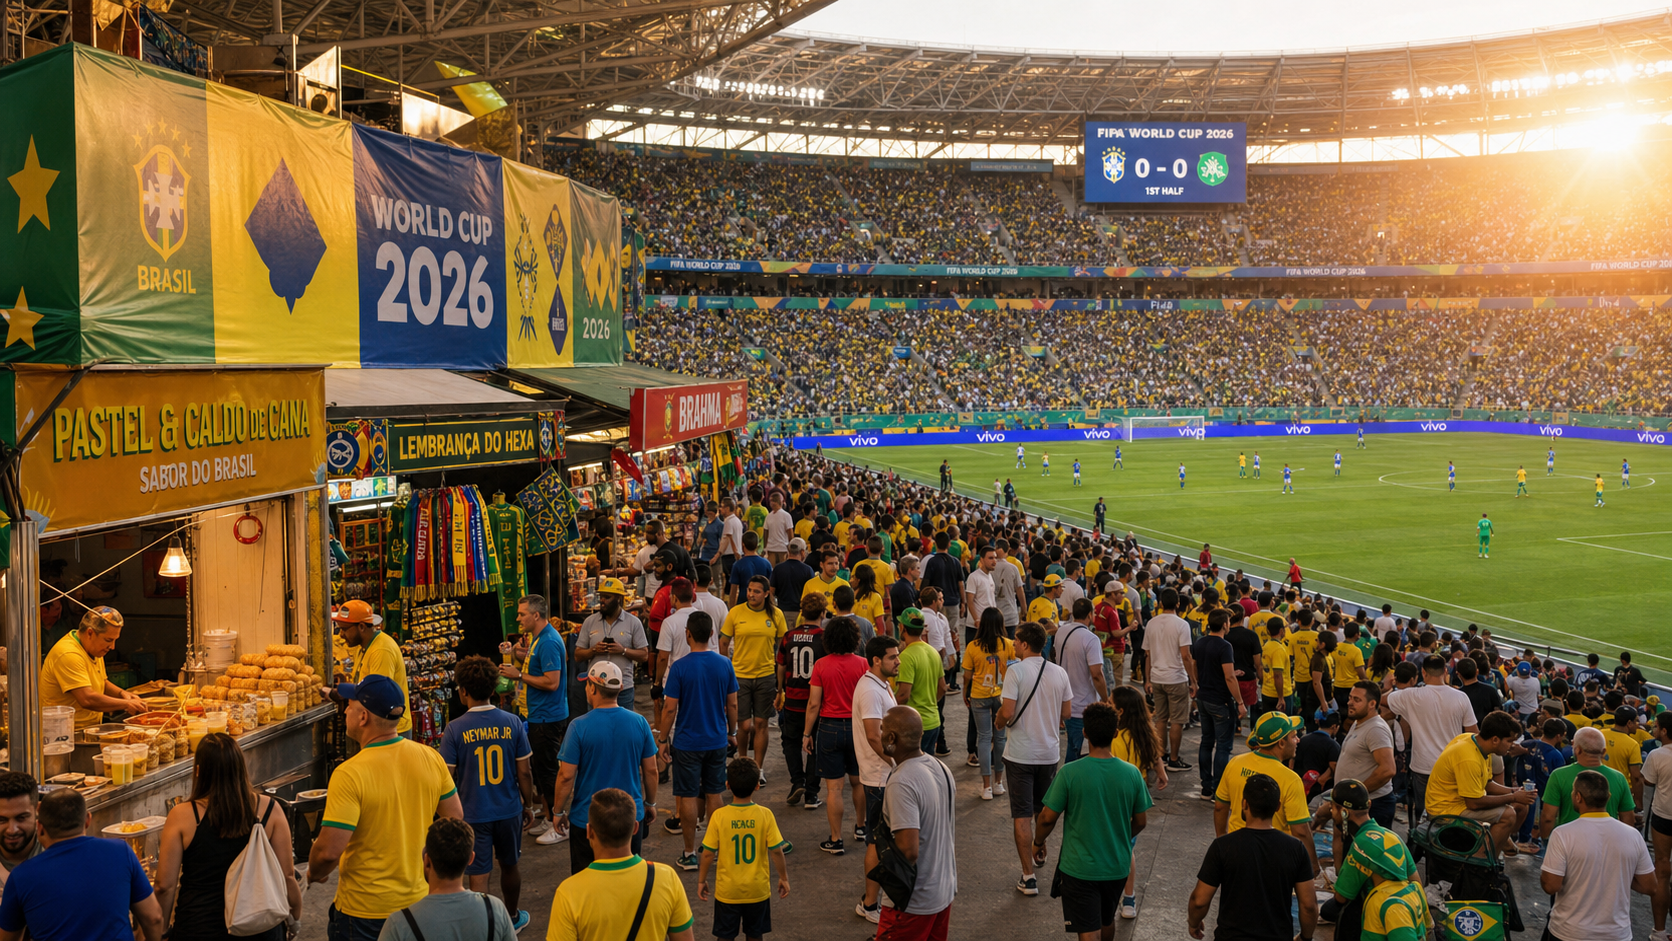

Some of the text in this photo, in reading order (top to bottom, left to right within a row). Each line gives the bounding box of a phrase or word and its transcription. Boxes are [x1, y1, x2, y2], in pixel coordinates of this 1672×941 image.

[1129, 128, 1175, 139] WORLD
[1178, 129, 1203, 139] CUP
[1206, 129, 1234, 139] 2026
[1135, 158, 1150, 179] 0
[1172, 158, 1188, 179] 0
[1145, 187, 1184, 196] 1ST HALF
[371, 194, 492, 246] WORLD CUP
[686, 261, 710, 269] WORLD
[962, 267, 986, 275] WORLD
[1303, 268, 1330, 276] WORLD
[1331, 268, 1347, 276] CUP
[1609, 261, 1640, 269] WORLD
[1641, 260, 1658, 268] CUP
[137, 265, 196, 294] BRASIL
[375, 241, 494, 329] 2026
[583, 317, 610, 339] 2026
[678, 392, 722, 433] BRAHMA
[53, 405, 153, 462] PASTEL
[159, 403, 179, 451] &
[184, 401, 248, 449] CALDO
[267, 399, 310, 440] CANA
[1084, 428, 1110, 439] vivo
[1285, 424, 1311, 436] vivo
[1421, 420, 1447, 432] vivo
[1539, 424, 1562, 437] vivo
[849, 434, 878, 446] vivo
[976, 430, 1005, 442] vivo
[1637, 430, 1665, 444] vivo
[399, 429, 535, 461] LEMBRANÇA DO HEXA
[140, 453, 257, 494] SABOR DO BRASIL
[790, 646, 814, 679] 10
[462, 727, 512, 744] NEYMAR JR
[474, 744, 504, 786] 10
[731, 833, 756, 865] 10
